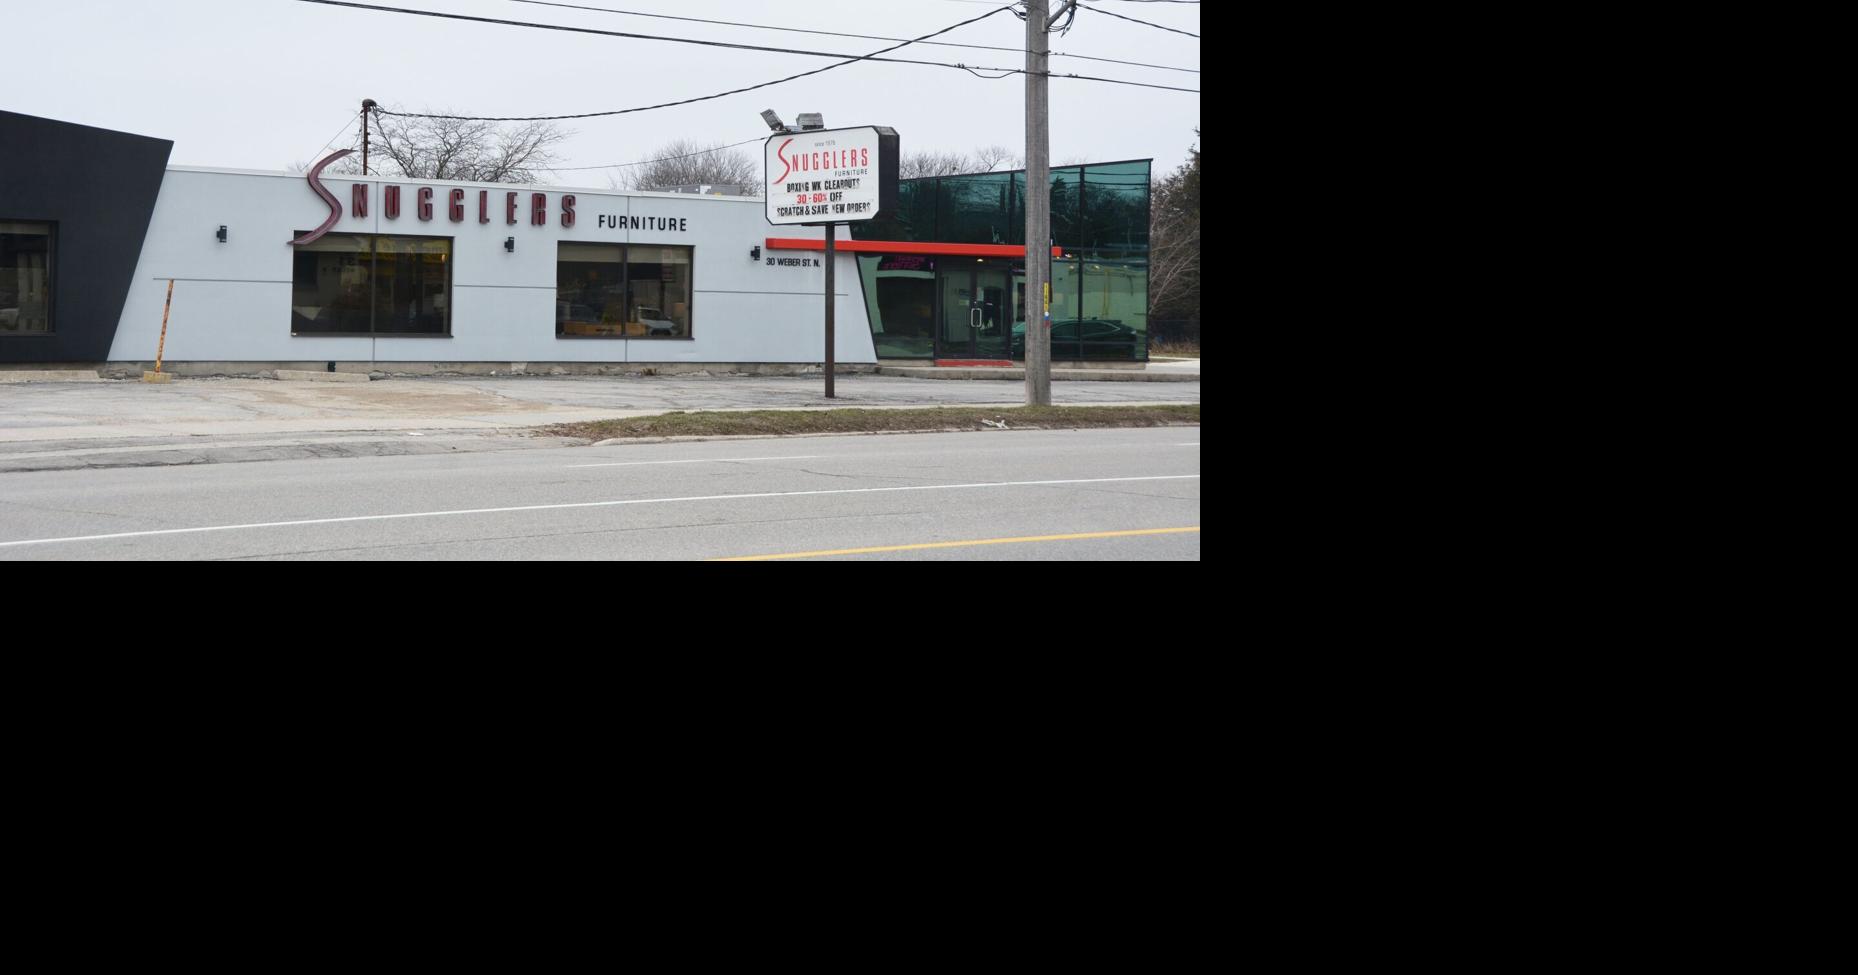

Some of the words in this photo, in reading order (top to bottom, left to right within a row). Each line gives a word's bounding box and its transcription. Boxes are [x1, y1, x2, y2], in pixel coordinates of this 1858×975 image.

[772, 138, 868, 185] SNUGGLERS
[834, 169, 868, 177] FURNITURE
[287, 148, 577, 245] SNUGGLERS
[797, 194, 807, 204] 30
[813, 192, 827, 203] 60%
[829, 191, 843, 202] OFF
[777, 205, 804, 217] SCRATCH
[811, 204, 829, 215] SAVE
[598, 214, 688, 232] FURNITURE
[766, 257, 776, 266] 30
[777, 258, 801, 267] WEBER
[813, 259, 821, 267] N.
